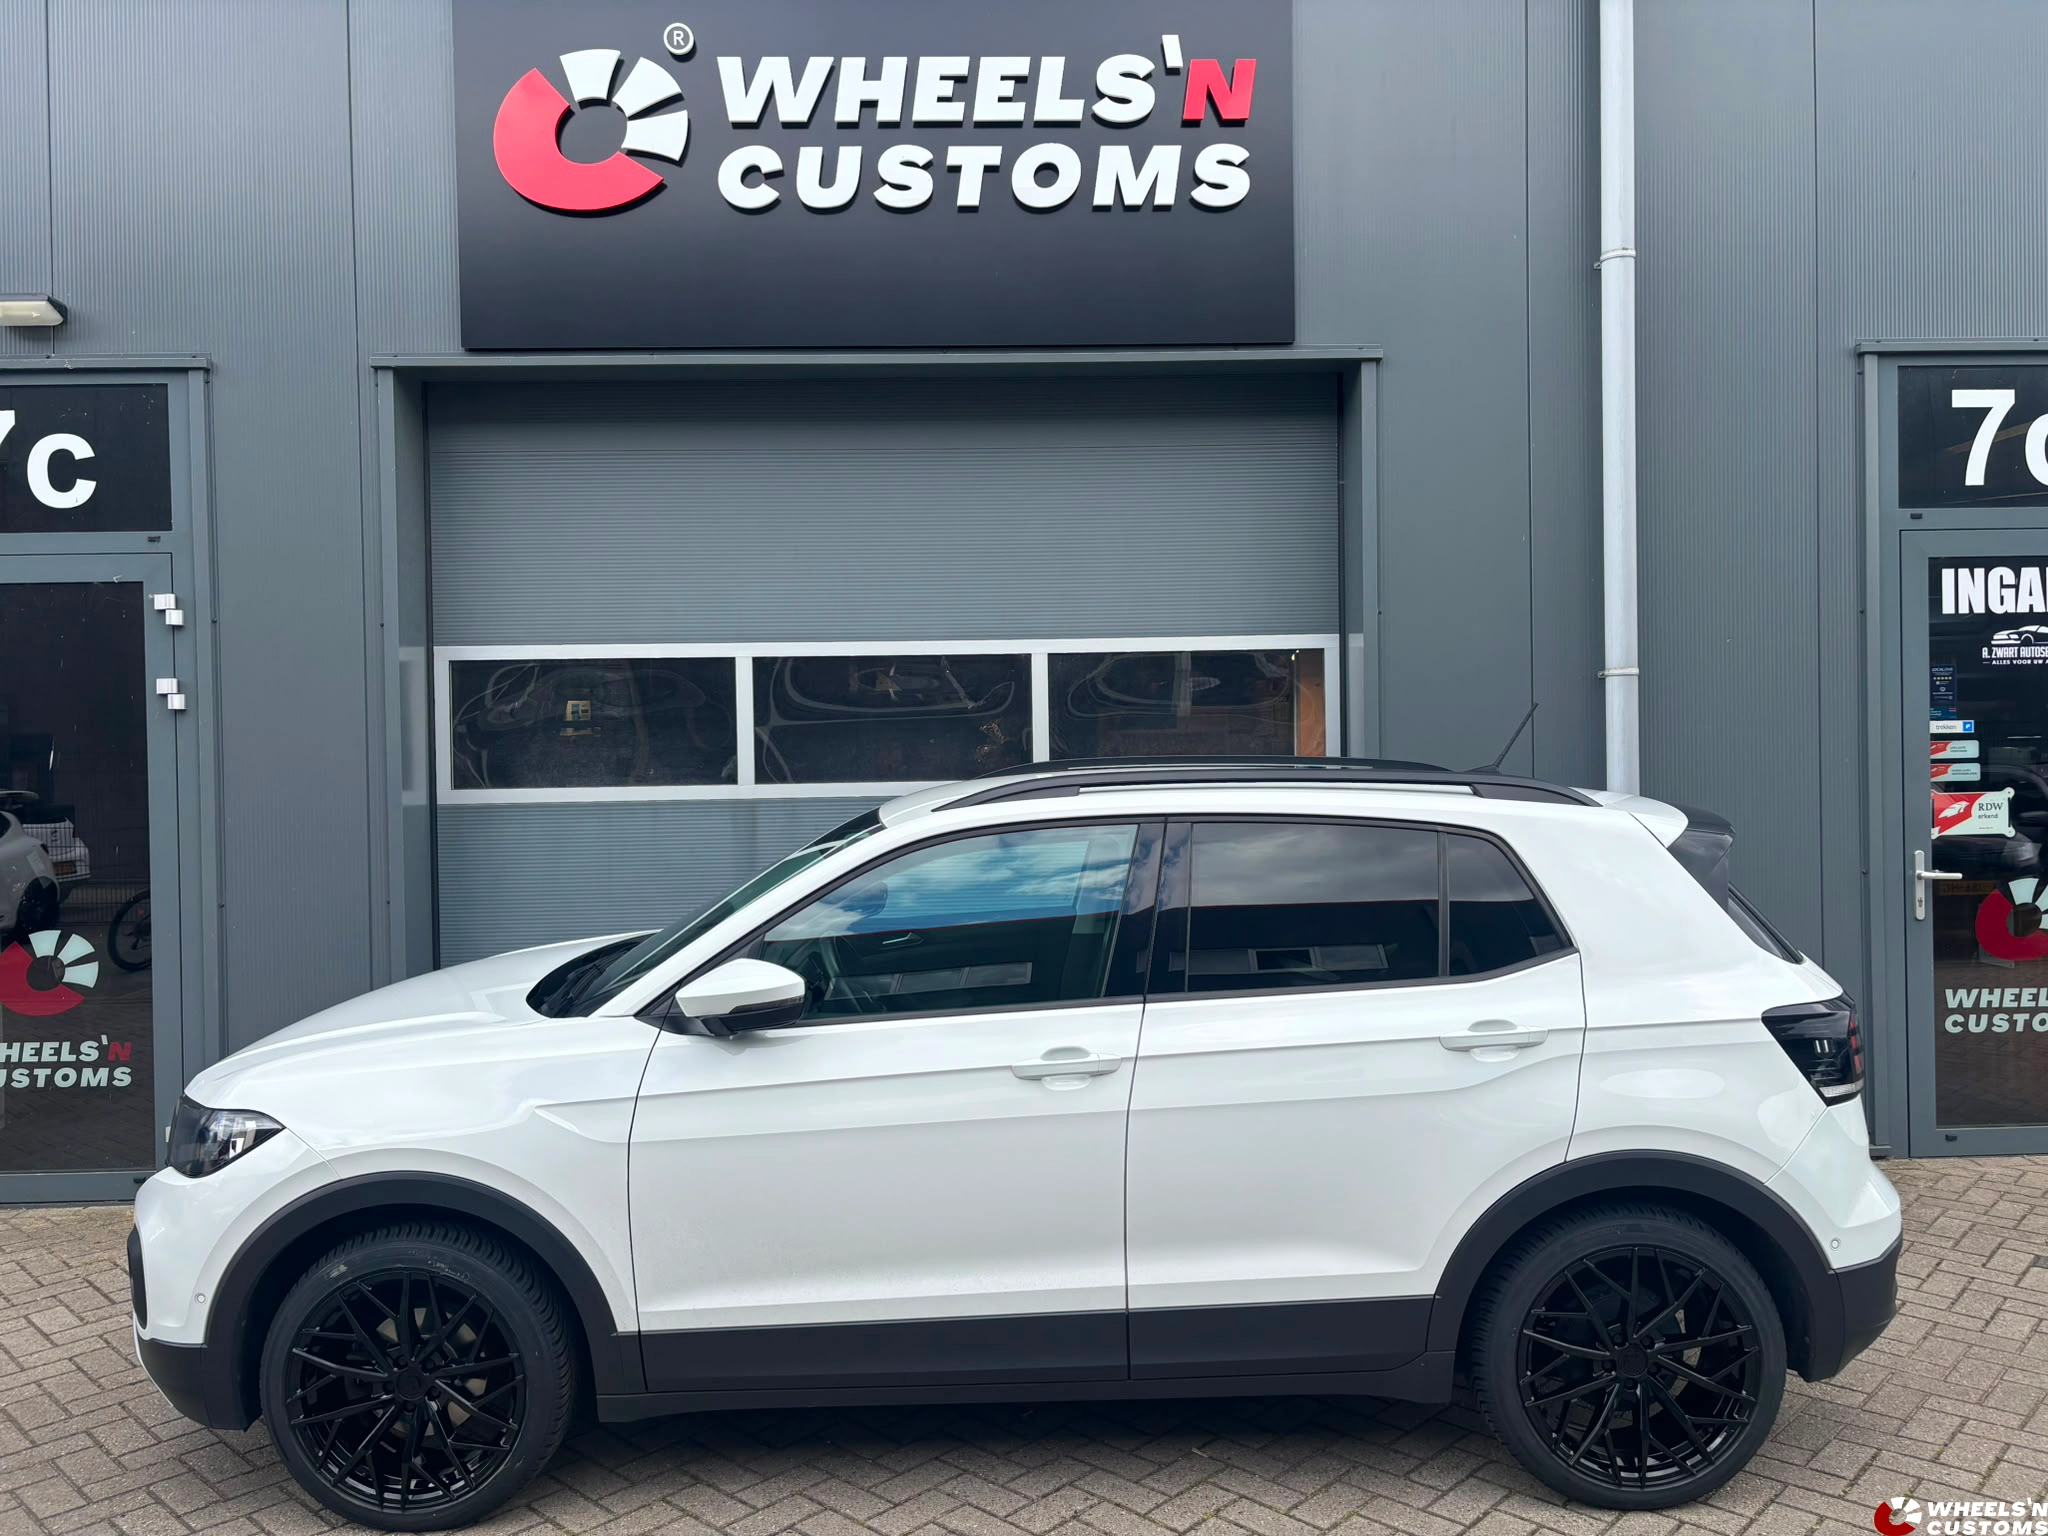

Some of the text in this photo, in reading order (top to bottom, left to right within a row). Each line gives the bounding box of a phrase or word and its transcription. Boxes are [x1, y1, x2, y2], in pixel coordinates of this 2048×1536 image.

[716, 34, 1257, 123] WHEELS'N
[717, 142, 1252, 209] CUSTOMS
[1941, 566, 2048, 615] INGA
[1991, 646, 2019, 659] ZWART
[1978, 802, 2004, 811] RDW
